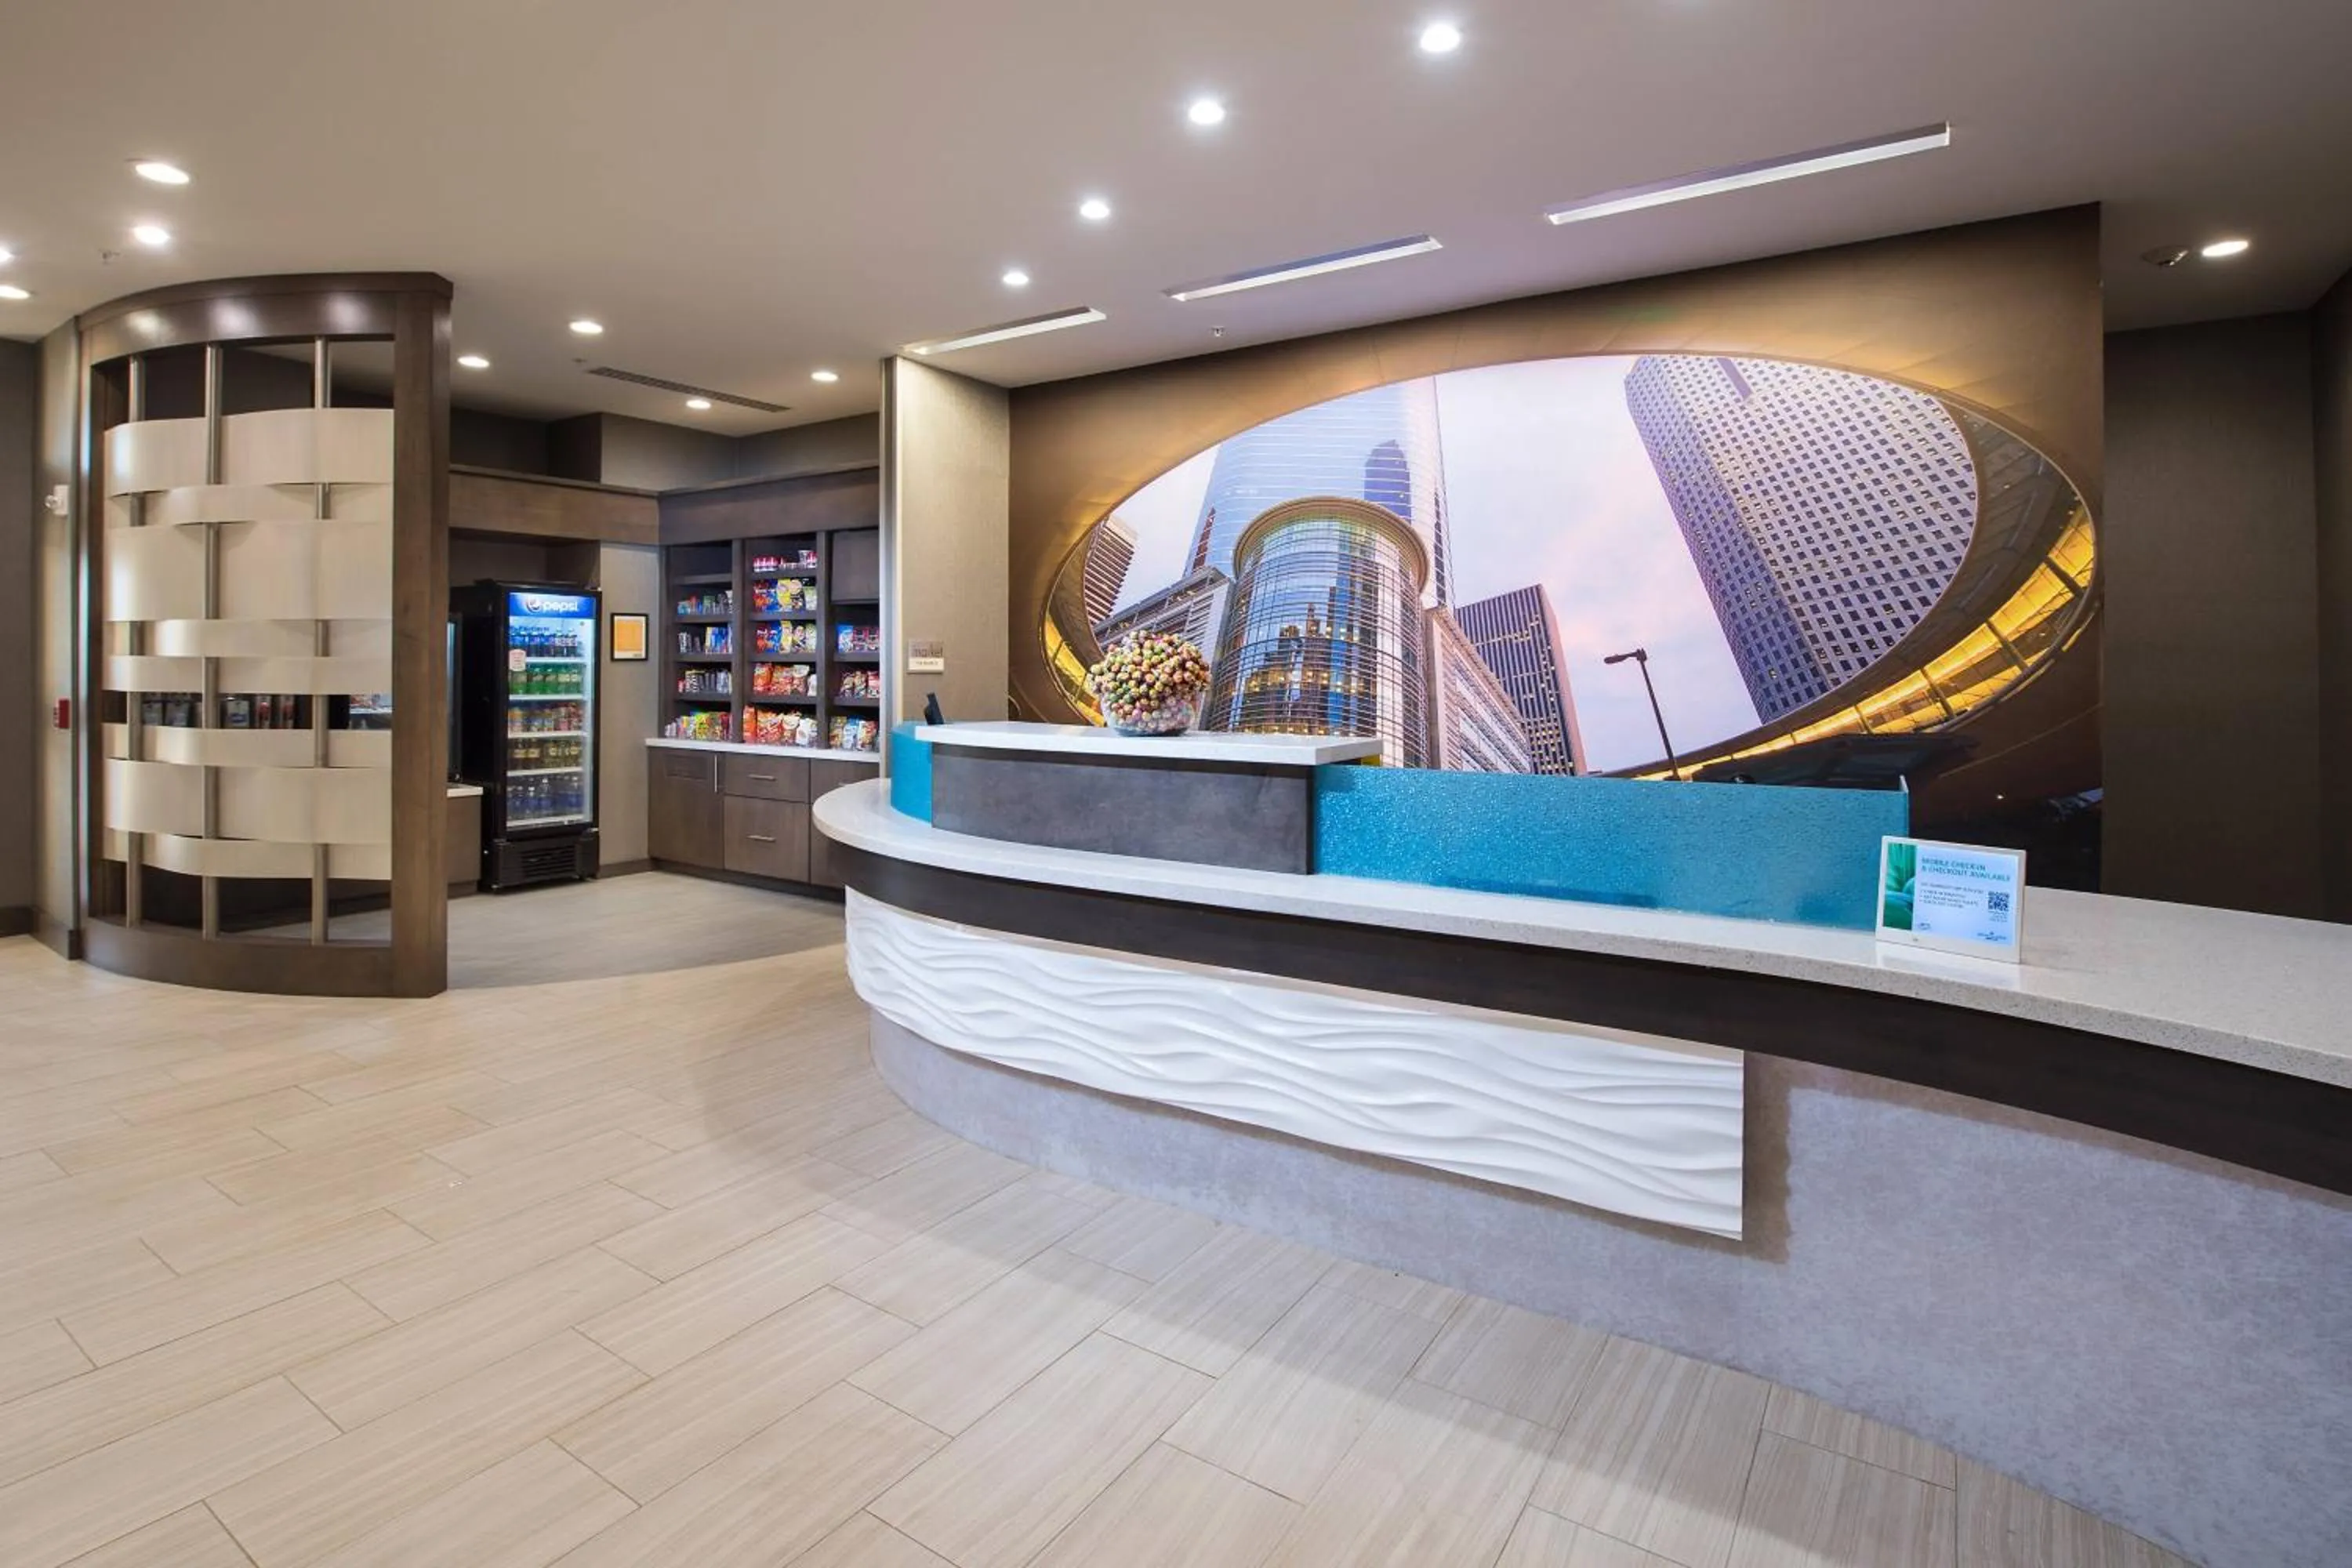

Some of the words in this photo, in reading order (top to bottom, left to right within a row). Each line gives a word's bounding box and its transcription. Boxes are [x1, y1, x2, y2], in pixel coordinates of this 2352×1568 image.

[543, 601, 579, 613] pepsi
[1922, 858, 1949, 866] MOBILE
[1929, 866, 1968, 876] CHECKOUT
[1969, 870, 2010, 881] AVAILABLE
